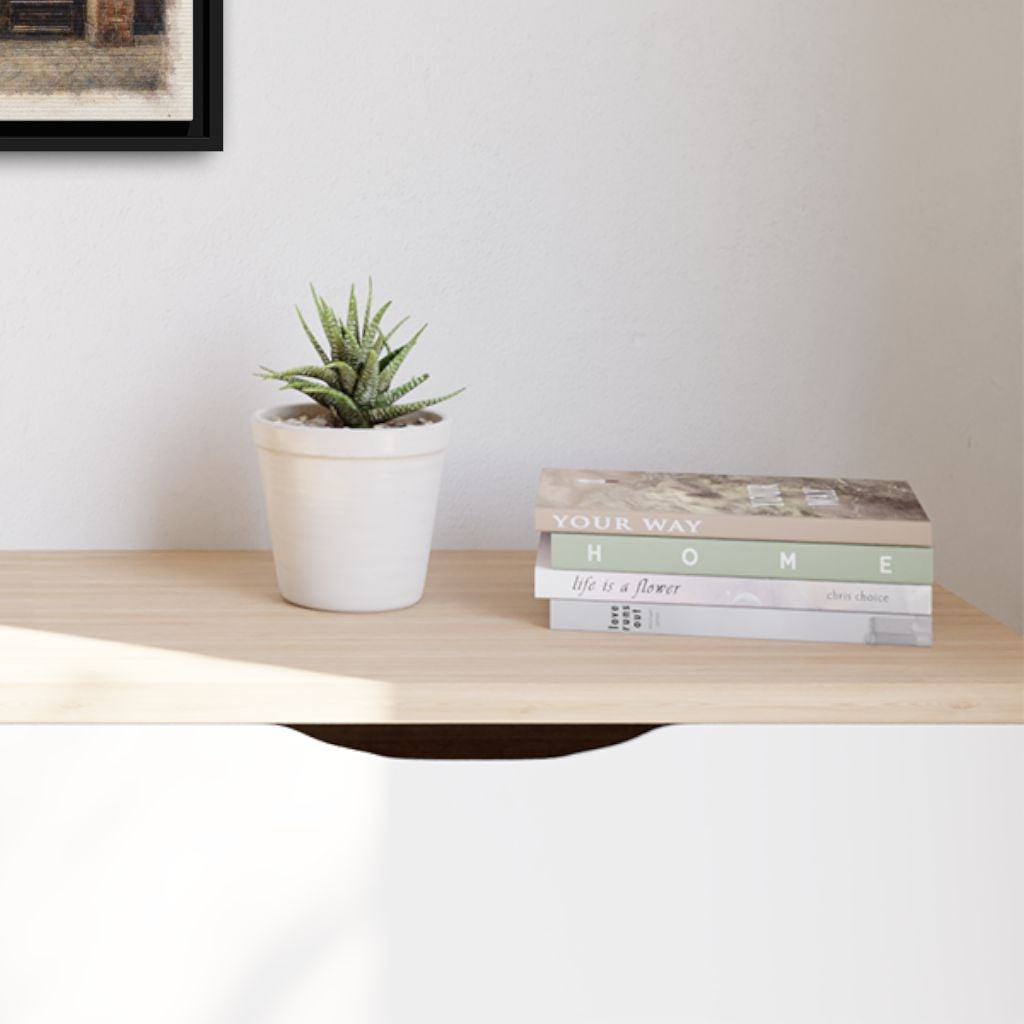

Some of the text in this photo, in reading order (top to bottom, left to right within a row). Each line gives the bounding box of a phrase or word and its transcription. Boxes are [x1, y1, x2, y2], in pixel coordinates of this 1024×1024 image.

[552, 514, 703, 533] YOUR WAY
[571, 575, 682, 599] life is a flower
[608, 605, 619, 629] love
